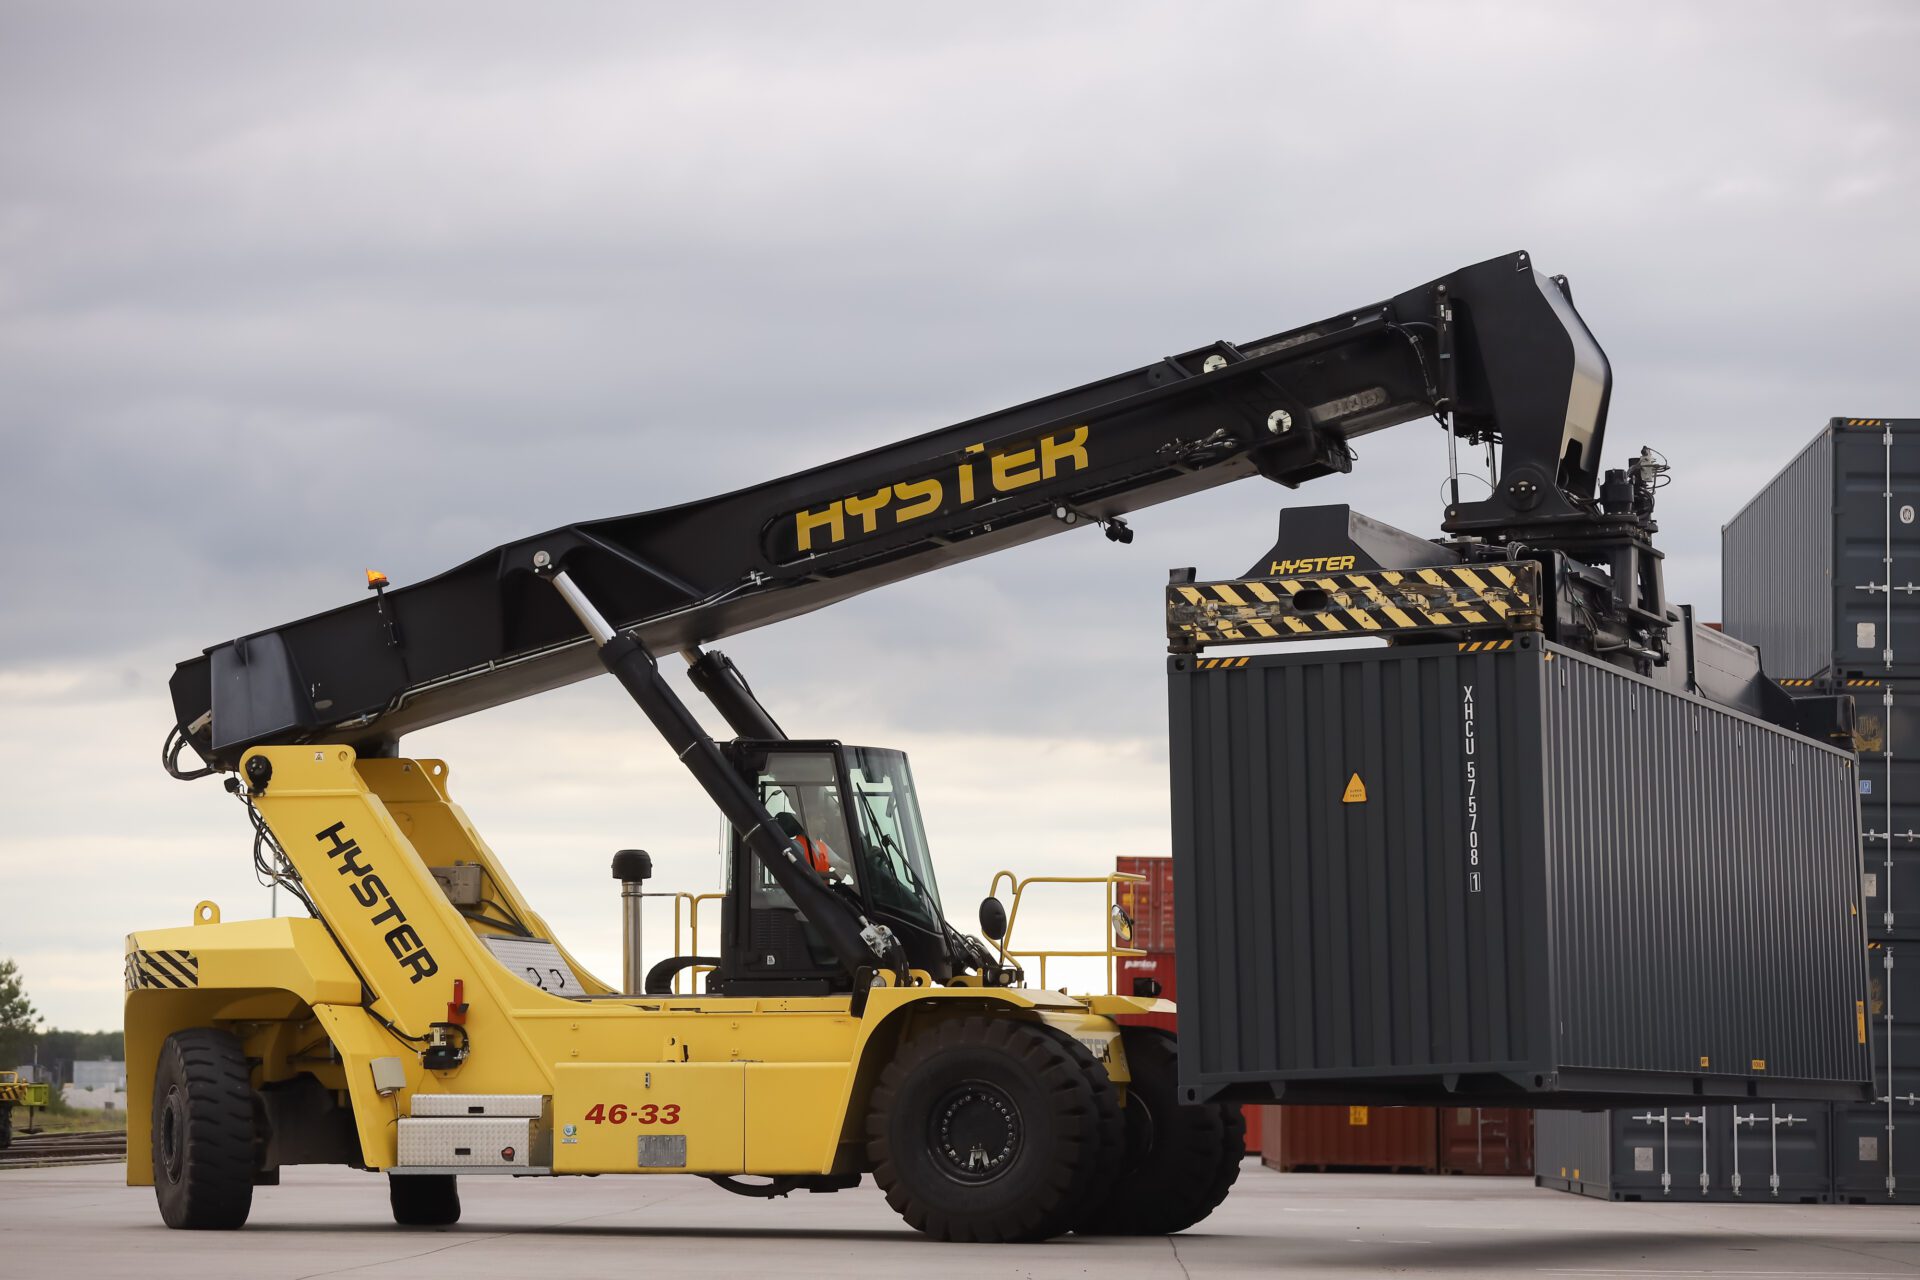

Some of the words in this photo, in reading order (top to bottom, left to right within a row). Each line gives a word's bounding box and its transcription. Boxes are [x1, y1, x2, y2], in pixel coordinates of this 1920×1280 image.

[796, 425, 1090, 552] HYSTER
[1269, 555, 1356, 576] HYSTER
[1464, 685, 1474, 754] XHCU
[1467, 761, 1478, 865] 575708
[315, 820, 439, 985] HYSTER
[1471, 873, 1480, 891] 1
[584, 1103, 681, 1125] 46-33
